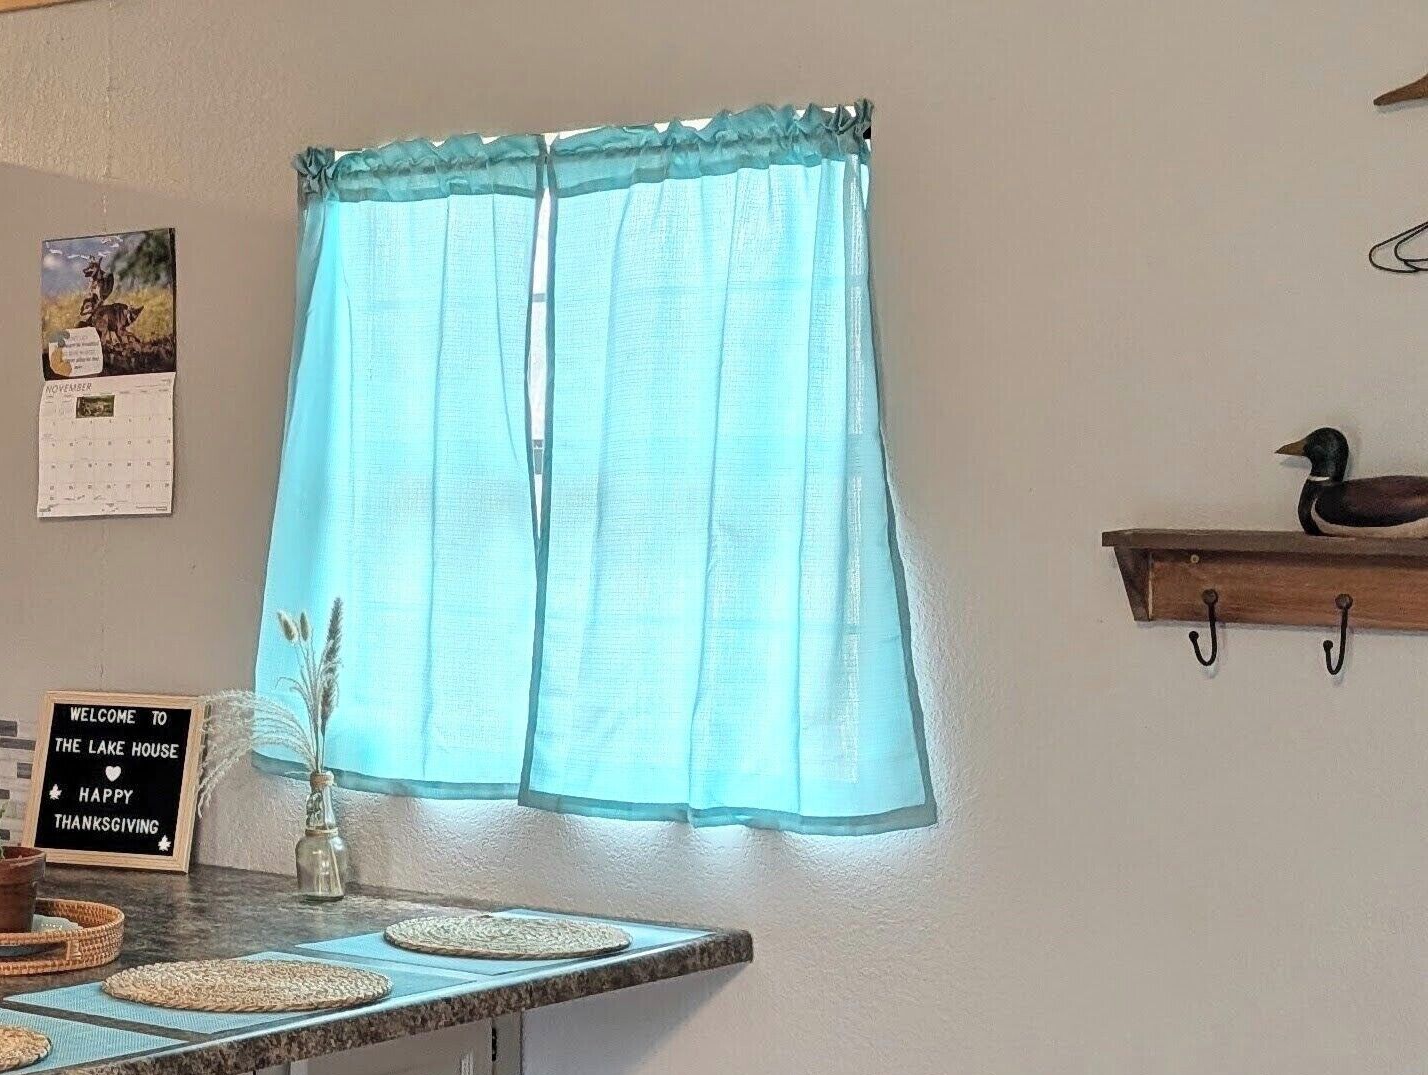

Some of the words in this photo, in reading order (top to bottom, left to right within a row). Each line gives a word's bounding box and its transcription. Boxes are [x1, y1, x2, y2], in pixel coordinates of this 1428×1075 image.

[45, 382, 92, 394] NOVEMBER
[70, 706, 137, 724] WELCOME
[151, 711, 168, 726] TO
[55, 737, 82, 753] THE
[88, 740, 125, 756] LAKE
[131, 742, 180, 759] HOUSE
[78, 787, 134, 805] HAPPY
[54, 814, 160, 835] THANKSGIVING
